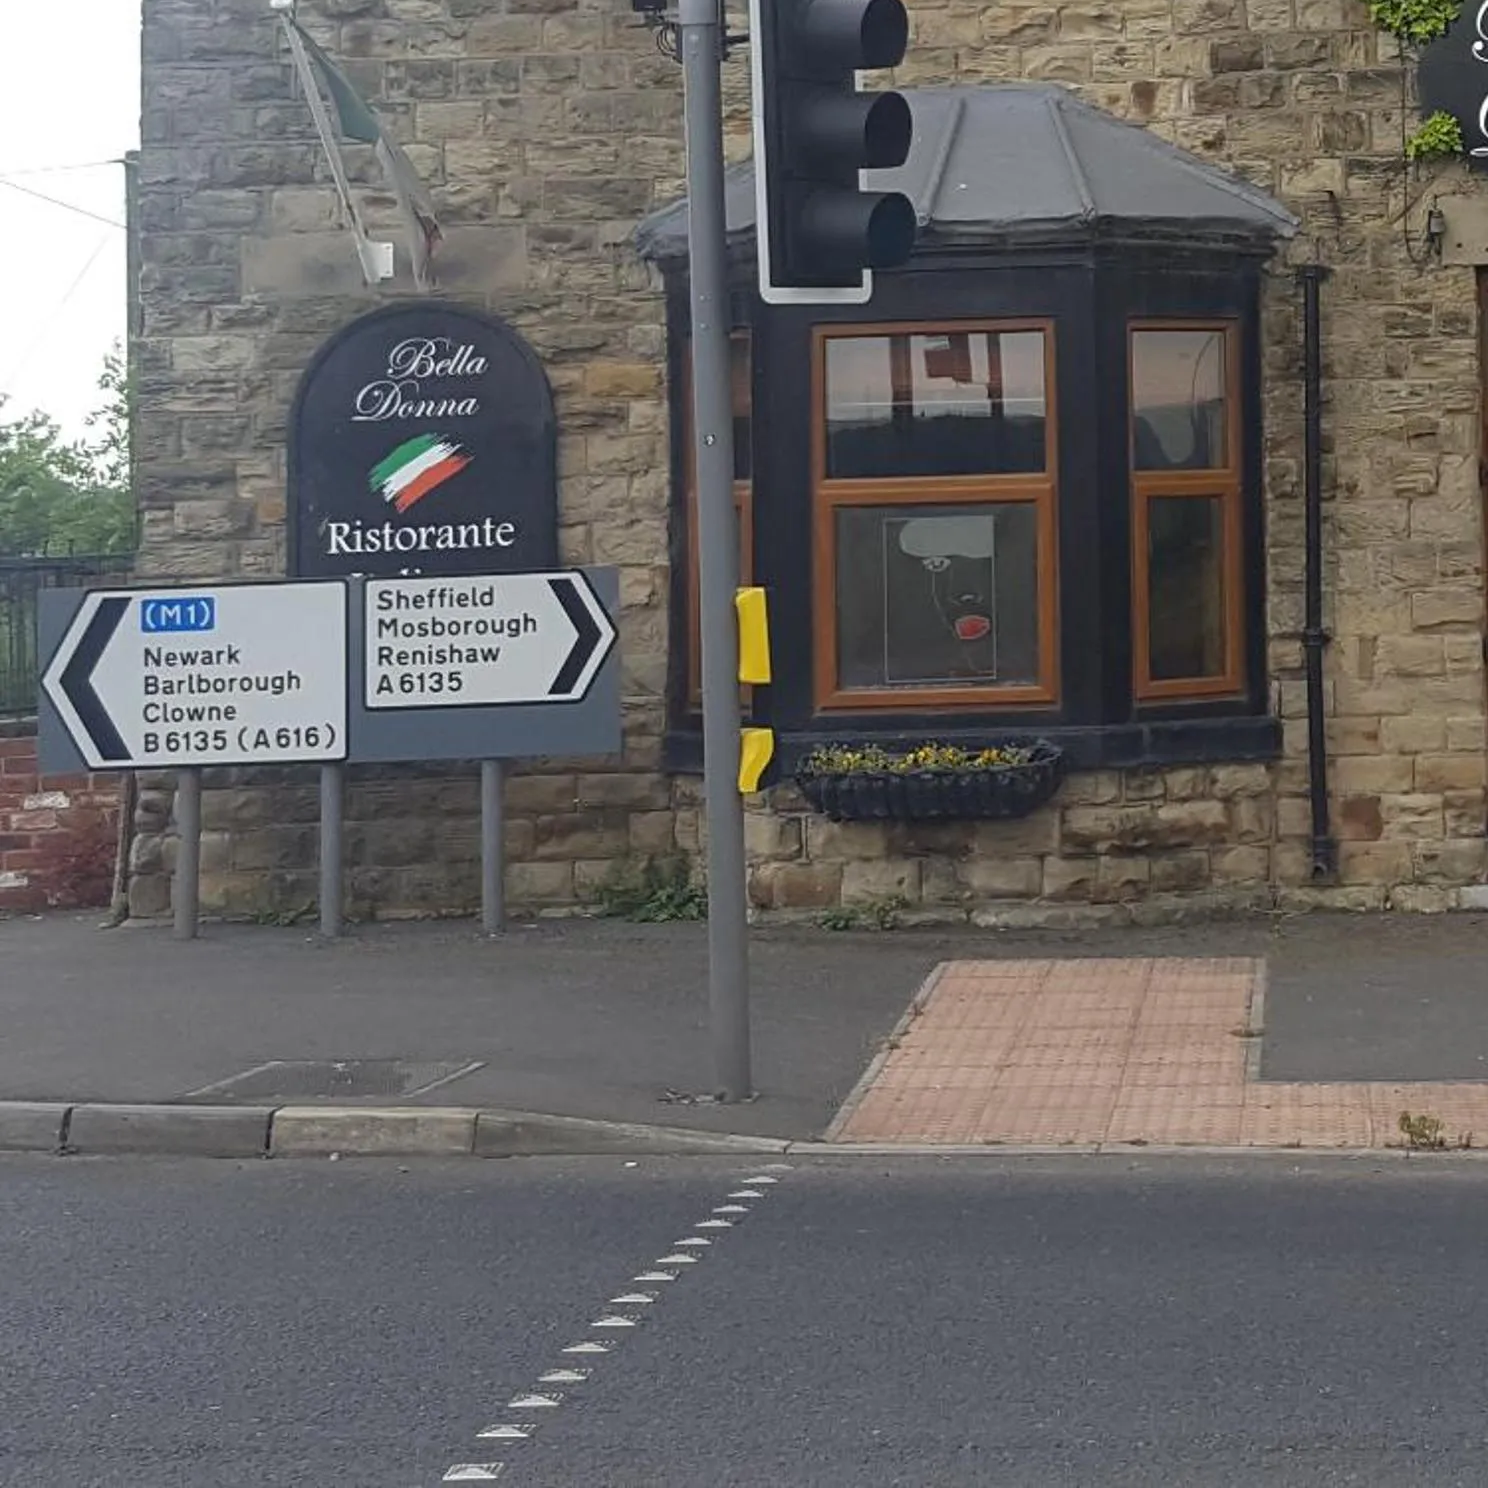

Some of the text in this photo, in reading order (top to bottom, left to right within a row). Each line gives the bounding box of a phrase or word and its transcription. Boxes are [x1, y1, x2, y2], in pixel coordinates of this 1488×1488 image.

[388, 337, 488, 379] Bella
[352, 380, 479, 421] Donna
[327, 518, 515, 554] Ristorante
[377, 585, 495, 610] Sheffield
[145, 600, 210, 629] (M1)
[378, 613, 537, 638] Mosborough
[144, 644, 241, 667] Newark
[378, 644, 500, 666] Renishaw
[144, 670, 301, 695] Barlborough
[143, 702, 237, 723] Clowne
